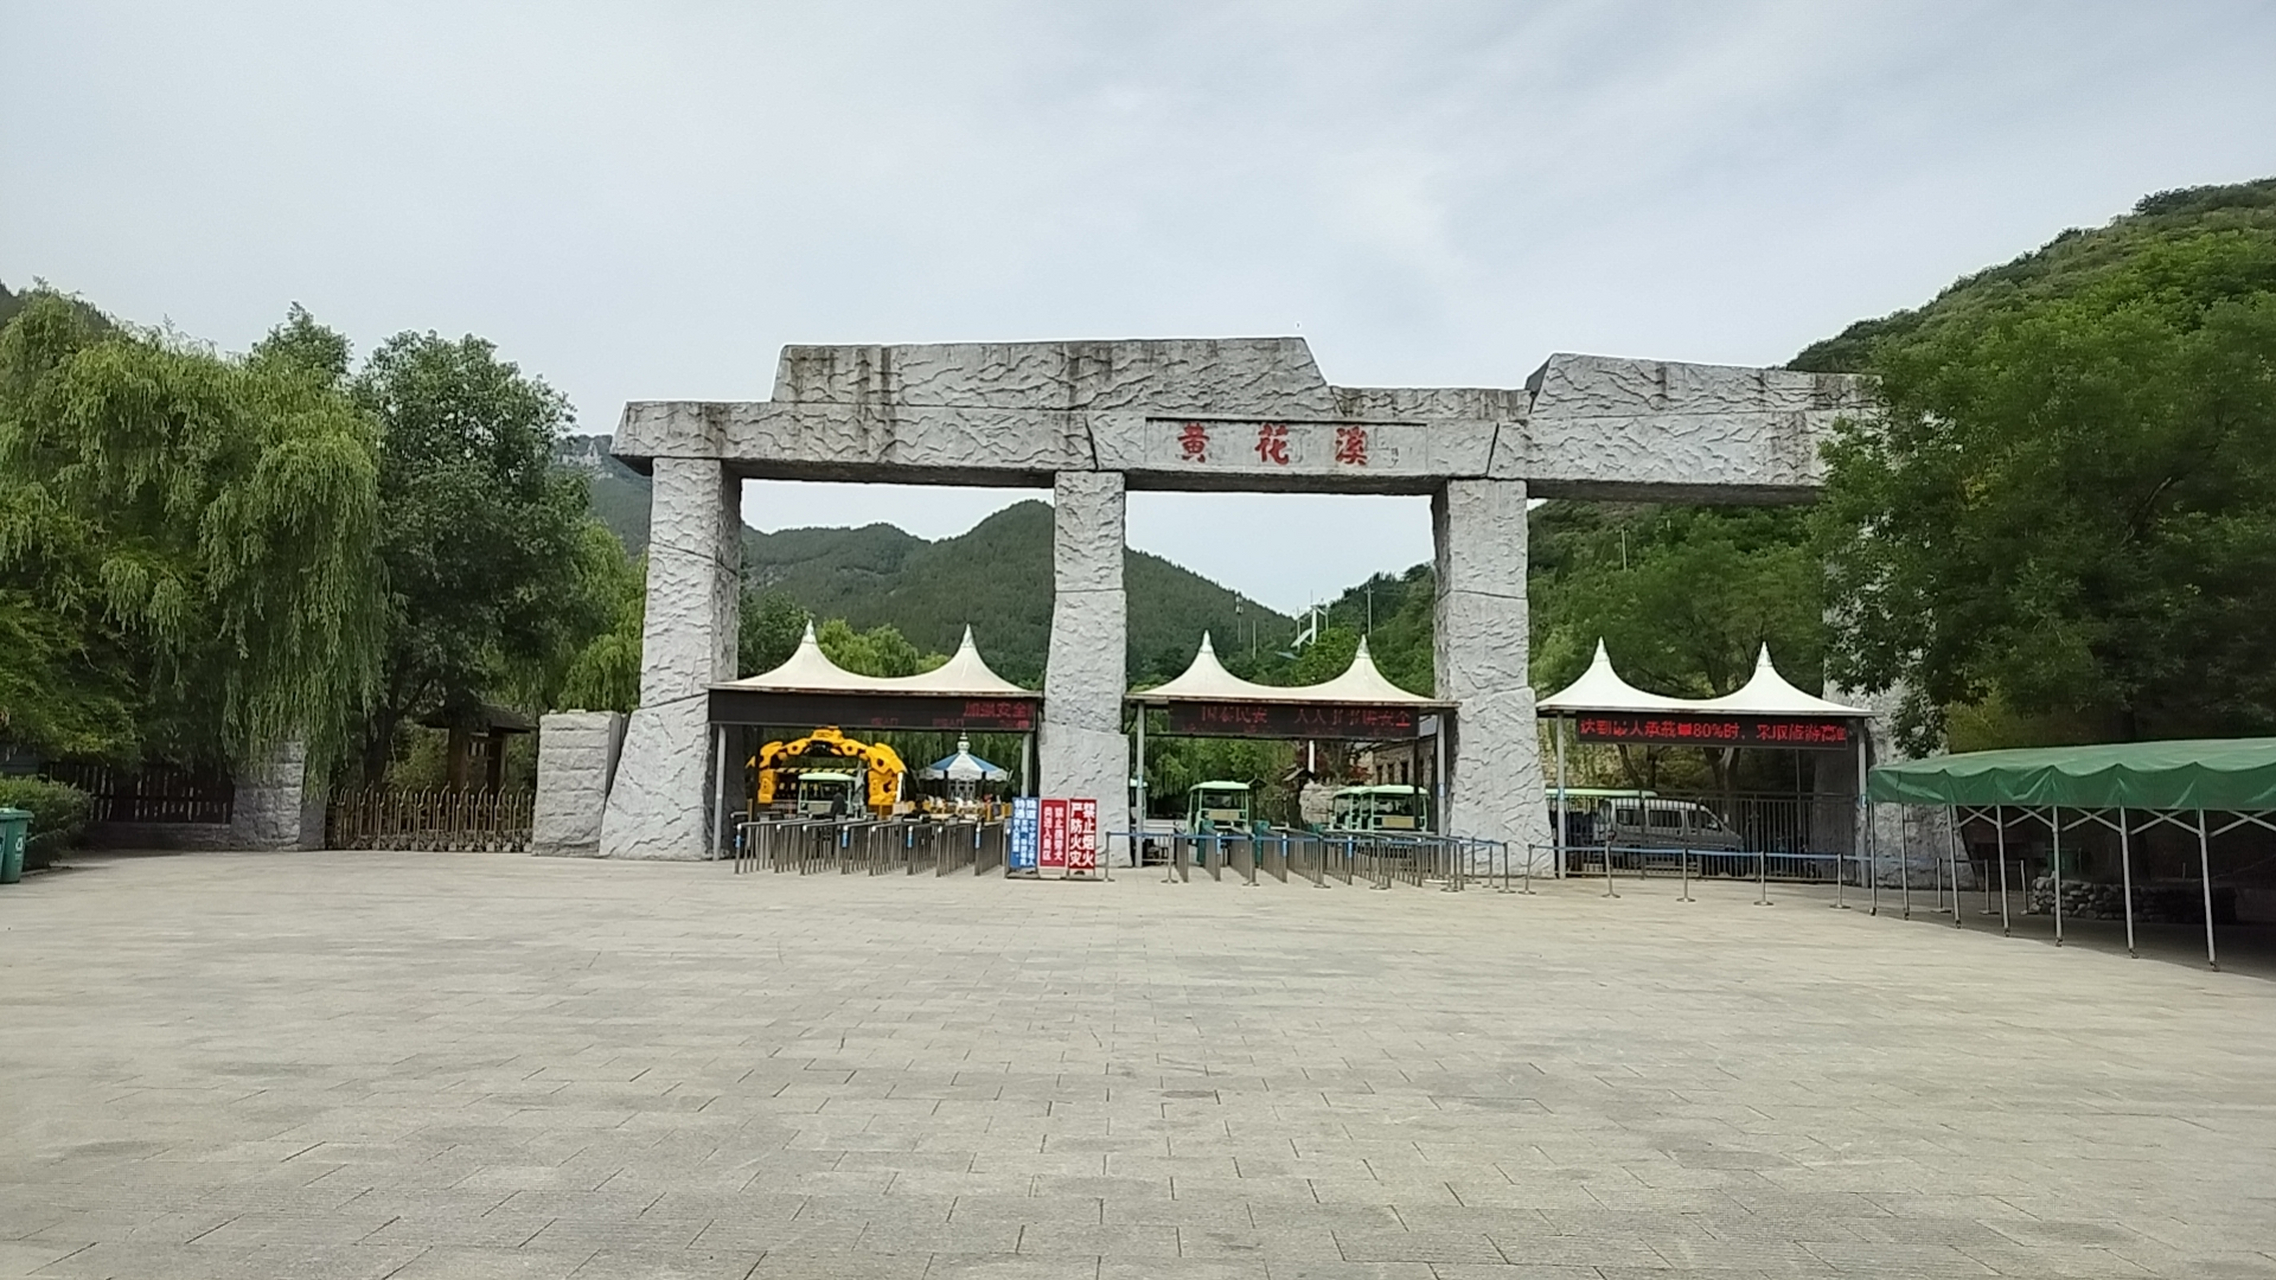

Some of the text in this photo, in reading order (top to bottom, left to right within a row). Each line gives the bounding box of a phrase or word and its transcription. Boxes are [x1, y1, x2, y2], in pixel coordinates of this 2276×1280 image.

[1177, 422, 1367, 465] 黄花溪
[1069, 802, 1083, 867] 严防火灾
[1082, 802, 1096, 867] 禁止烟火
